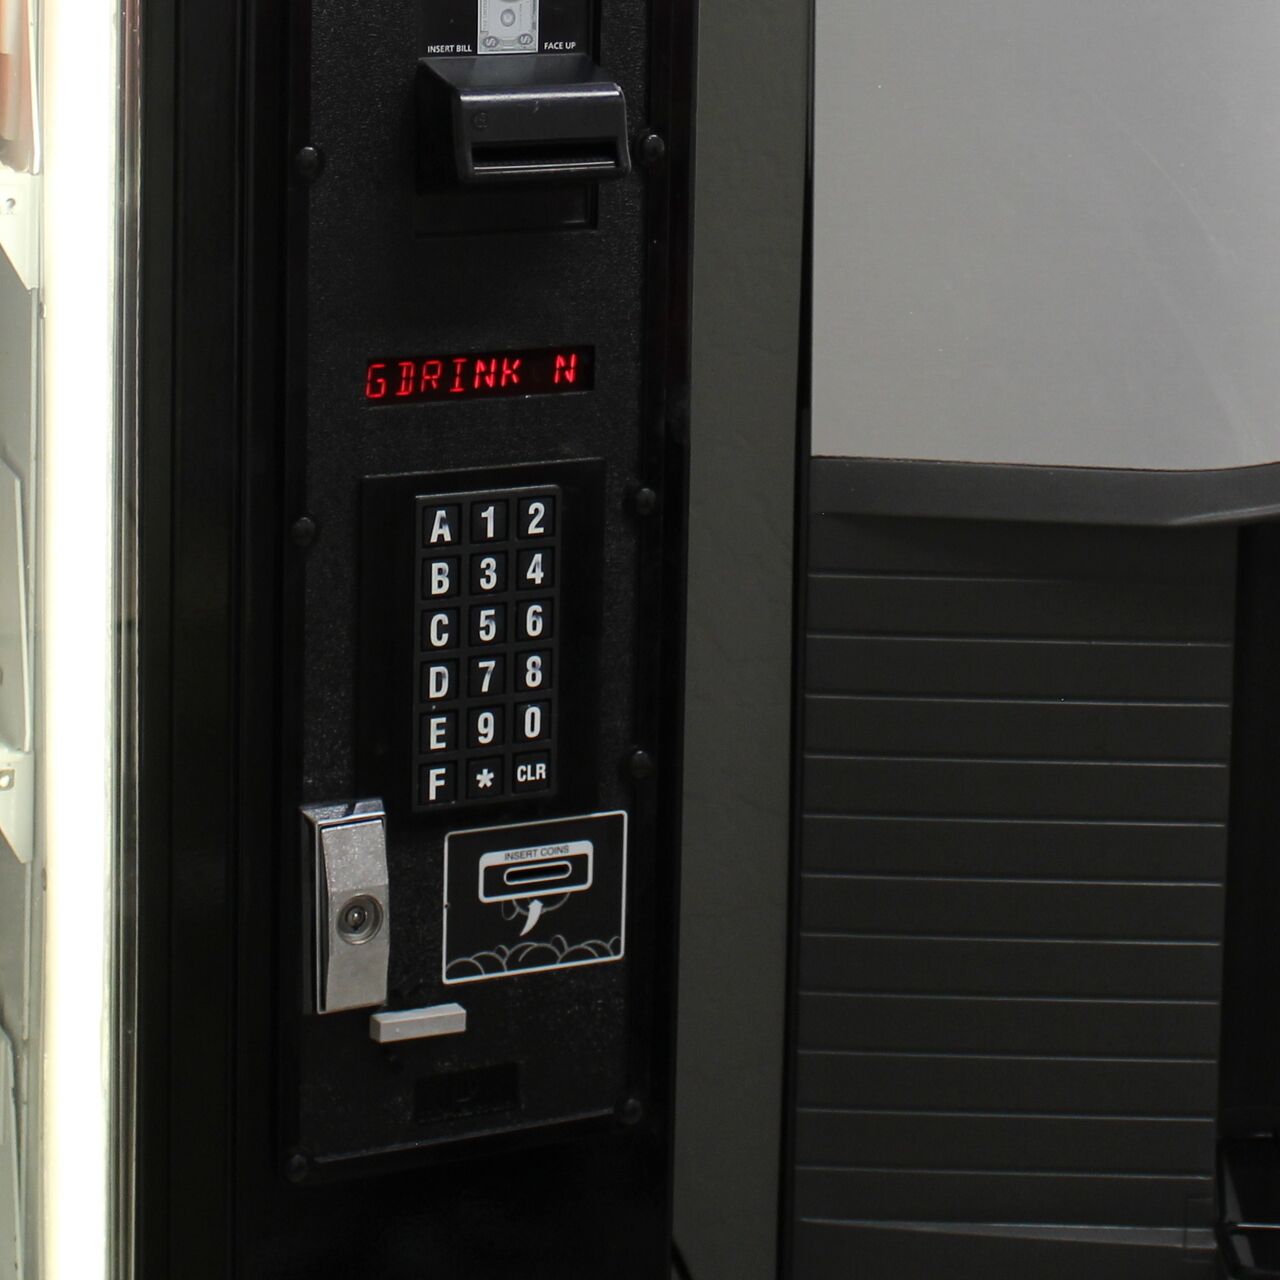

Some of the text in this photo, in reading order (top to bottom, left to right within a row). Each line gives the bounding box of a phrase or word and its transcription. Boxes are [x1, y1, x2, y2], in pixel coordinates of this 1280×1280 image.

[427, 44, 472, 53] INSERT BILL
[543, 41, 577, 50] FACE UP
[365, 353, 577, 399] GDRINK N
[429, 502, 546, 543] A 1 2
[431, 553, 544, 595] B 3 4
[429, 604, 543, 648] C 5 6
[429, 655, 542, 699] D 7 8
[429, 706, 541, 750] E 9 0
[428, 763, 546, 801] F CLR
[504, 845, 569, 861] INSERT COINS
